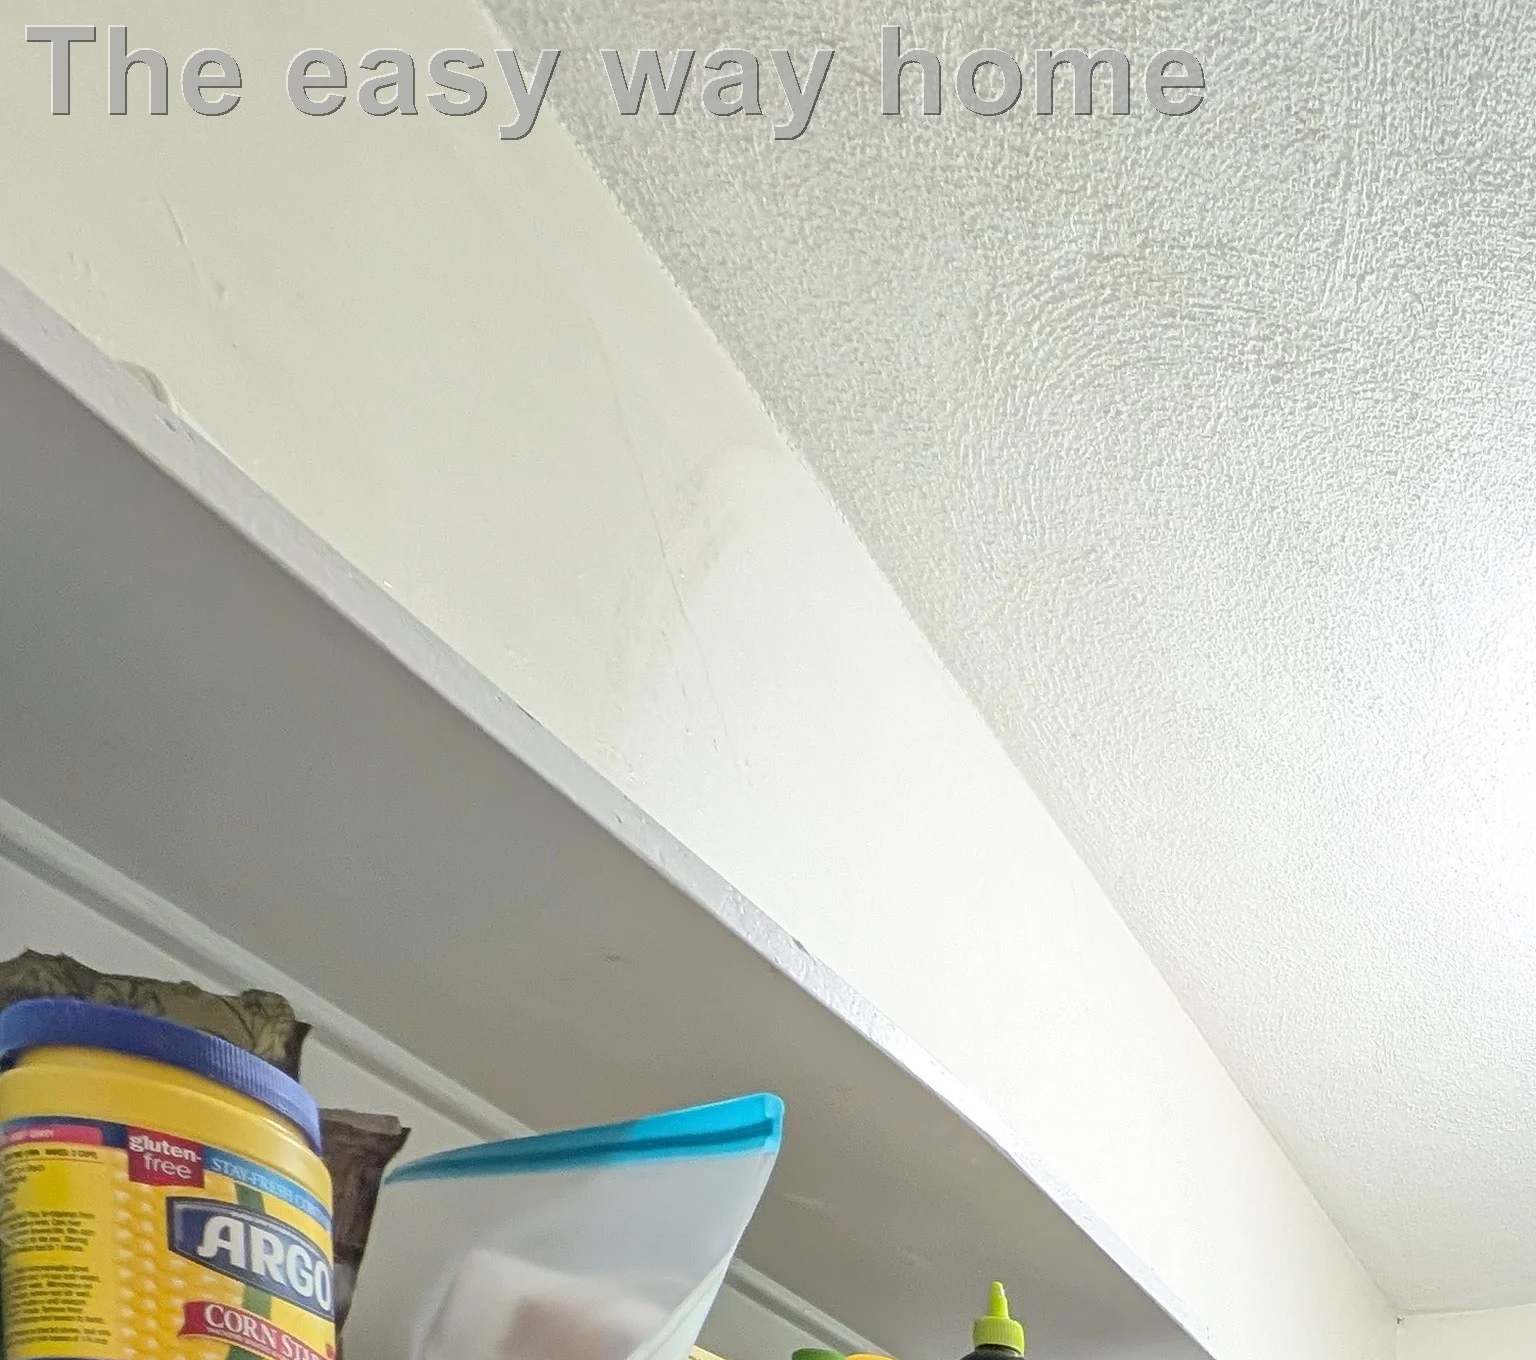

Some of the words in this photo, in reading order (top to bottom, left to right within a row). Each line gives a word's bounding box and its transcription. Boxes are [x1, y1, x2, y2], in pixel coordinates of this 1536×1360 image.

[142, 1152, 192, 1180] free
[197, 1214, 333, 1312] ARGO
[203, 1303, 279, 1349] CORN
